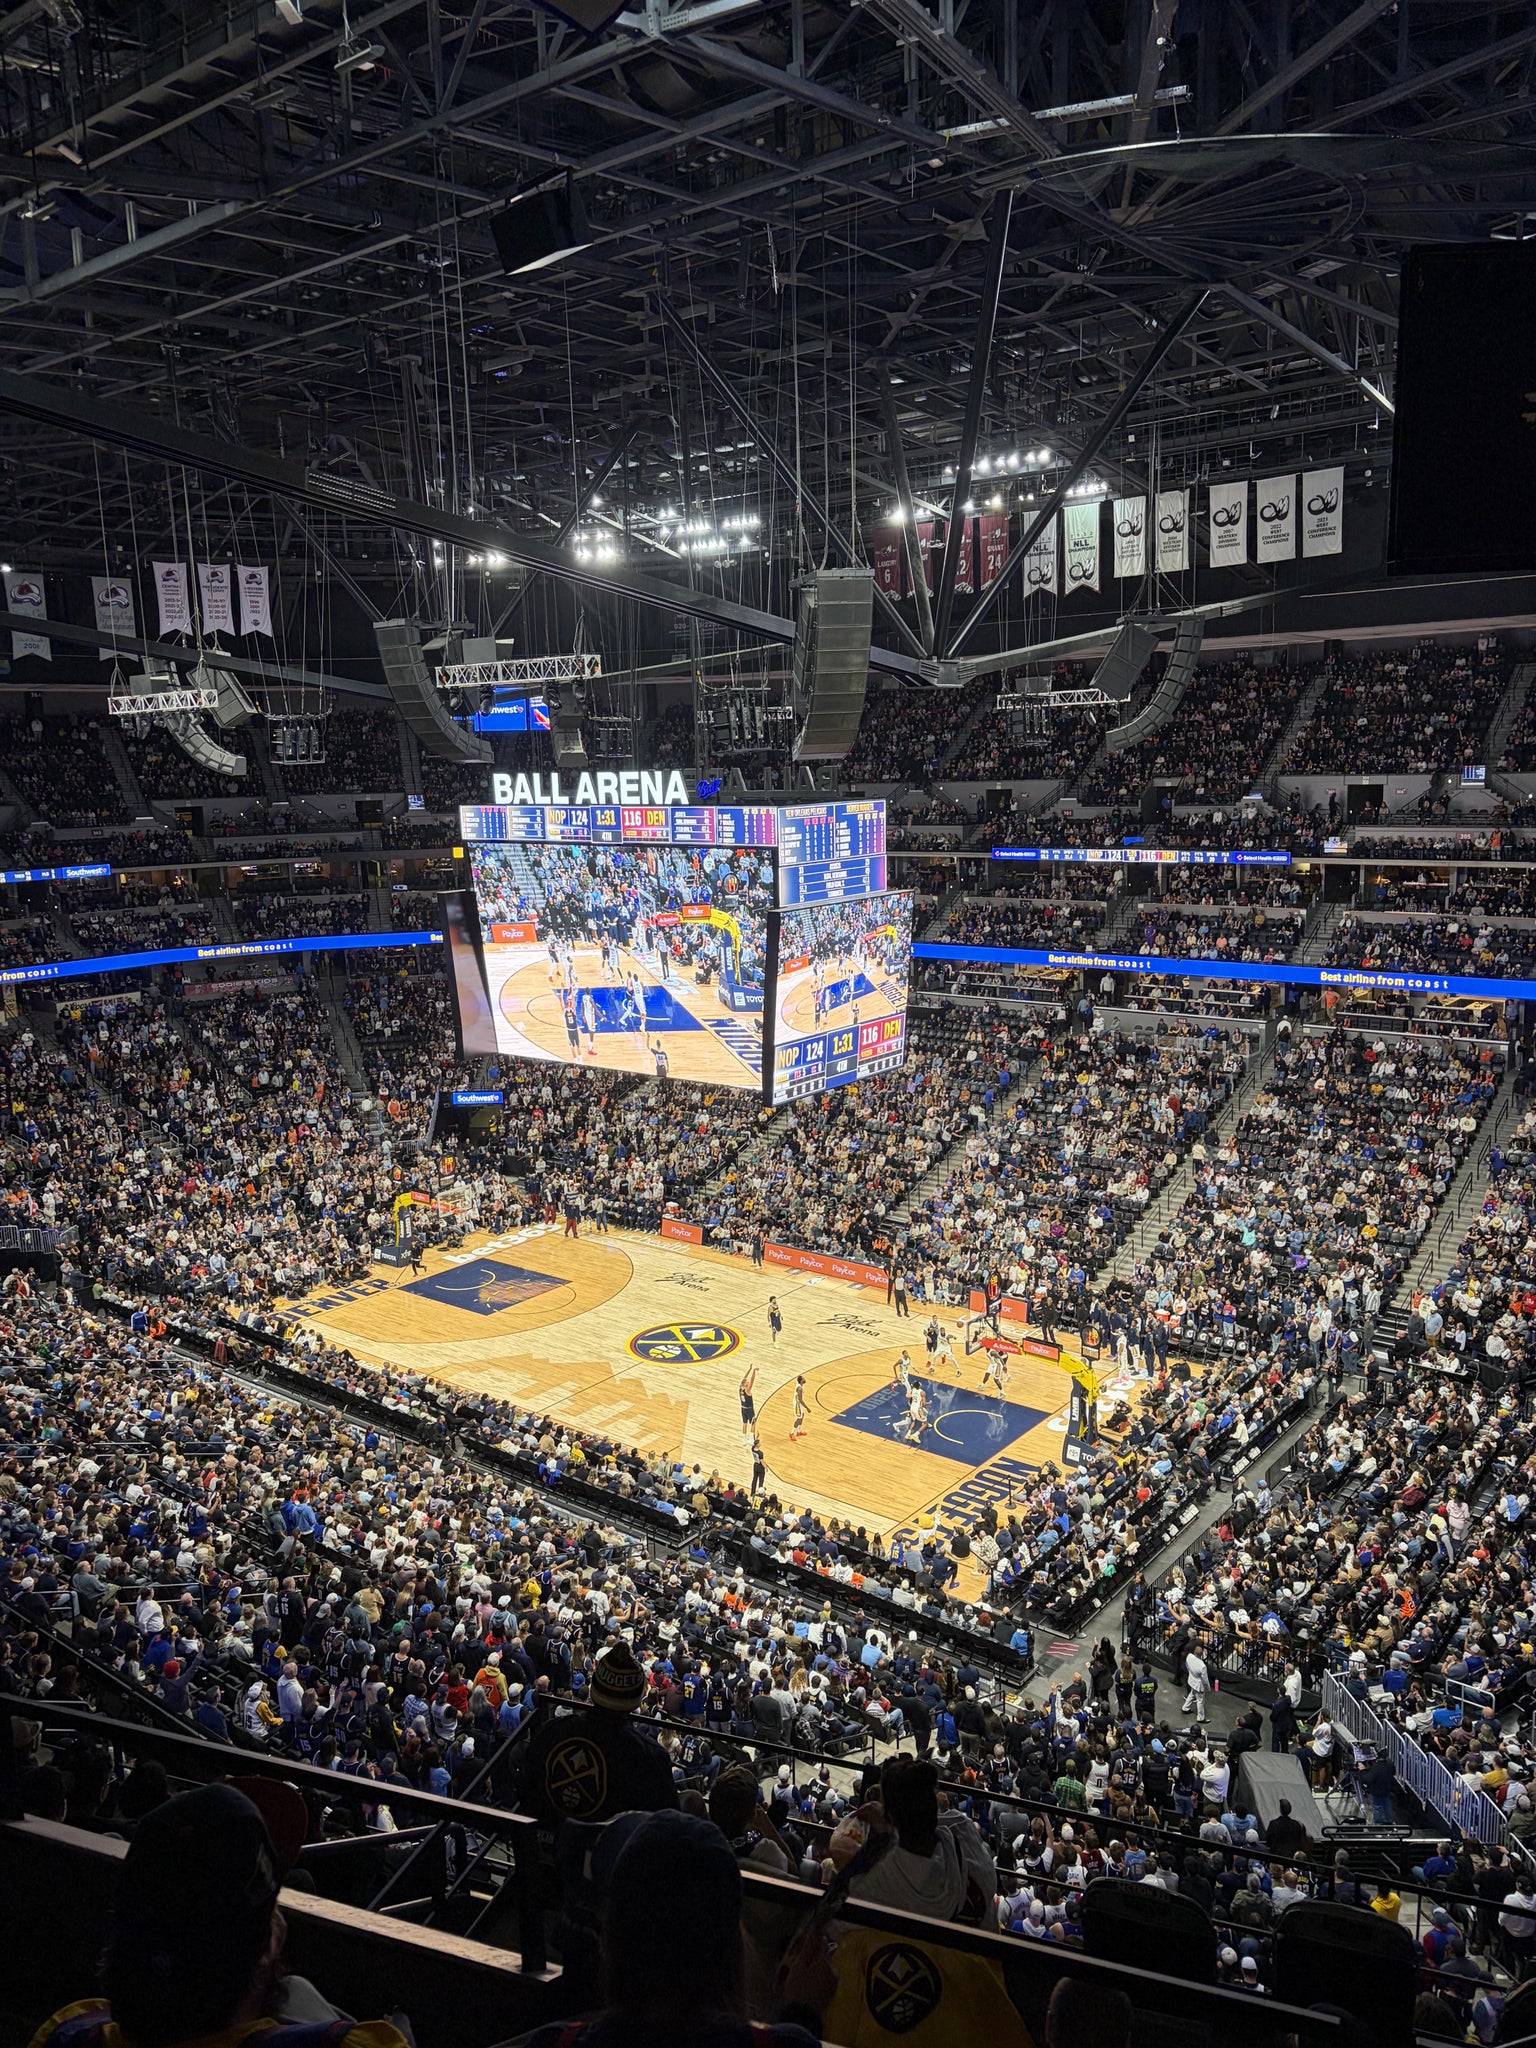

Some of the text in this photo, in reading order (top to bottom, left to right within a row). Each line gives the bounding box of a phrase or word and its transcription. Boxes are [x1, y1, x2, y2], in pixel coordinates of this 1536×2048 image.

[1308, 526, 1336, 534] CONFERENCE
[987, 544, 1004, 552] GRANT
[988, 554, 1001, 570] 24
[884, 569, 890, 583] 6
[493, 770, 689, 804] BALL ARENA
[696, 778, 722, 800] Ball
[549, 810, 566, 824] NOP
[571, 810, 588, 826] 124
[596, 810, 616, 826] 1:31
[624, 811, 641, 826] 116
[647, 811, 665, 826] DEN
[1108, 851, 1121, 860] 124
[1142, 852, 1156, 862] 116
[1163, 852, 1176, 862] DEN
[66, 868, 102, 876] Southwest
[502, 930, 524, 938] Paycor
[216, 947, 240, 955] airline
[242, 945, 262, 953] from
[1048, 954, 1065, 963] Best
[1067, 956, 1093, 965] airline
[1094, 957, 1116, 966] from
[2, 972, 25, 980] from
[1320, 972, 1341, 982] Best
[1343, 973, 1375, 984] airline
[1377, 976, 1404, 986] from
[212, 980, 251, 988] EDDIE'S
[746, 995, 765, 1003] TOYO
[884, 1019, 901, 1040] DEN
[862, 1026, 878, 1046] 116
[833, 1032, 853, 1055] 1:31
[806, 1041, 823, 1061] 124
[777, 1046, 799, 1069] NOP
[837, 1060, 847, 1072] 4TH
[671, 1227, 692, 1237] Paycor
[442, 1222, 562, 1264] bet365
[618, 1233, 690, 1254] uchealth
[382, 1252, 397, 1262] TOYOTA
[769, 1250, 888, 1284] Paycor Paycor Paycor Payco
[675, 1280, 710, 1291] Arena
[269, 1279, 391, 1322] DENVER
[840, 1323, 880, 1337] Arena
[1031, 1346, 1050, 1355] Paycor
[1082, 1453, 1097, 1463] TOY
[281, 1604, 289, 1615] 15
[330, 1666, 338, 1677] 15
[599, 1668, 643, 1687] NUGGETS
[684, 1688, 695, 1699] 27
[713, 1700, 722, 1710] 15
[684, 1749, 694, 1763] 15
[1123, 1774, 1134, 1783] 32
